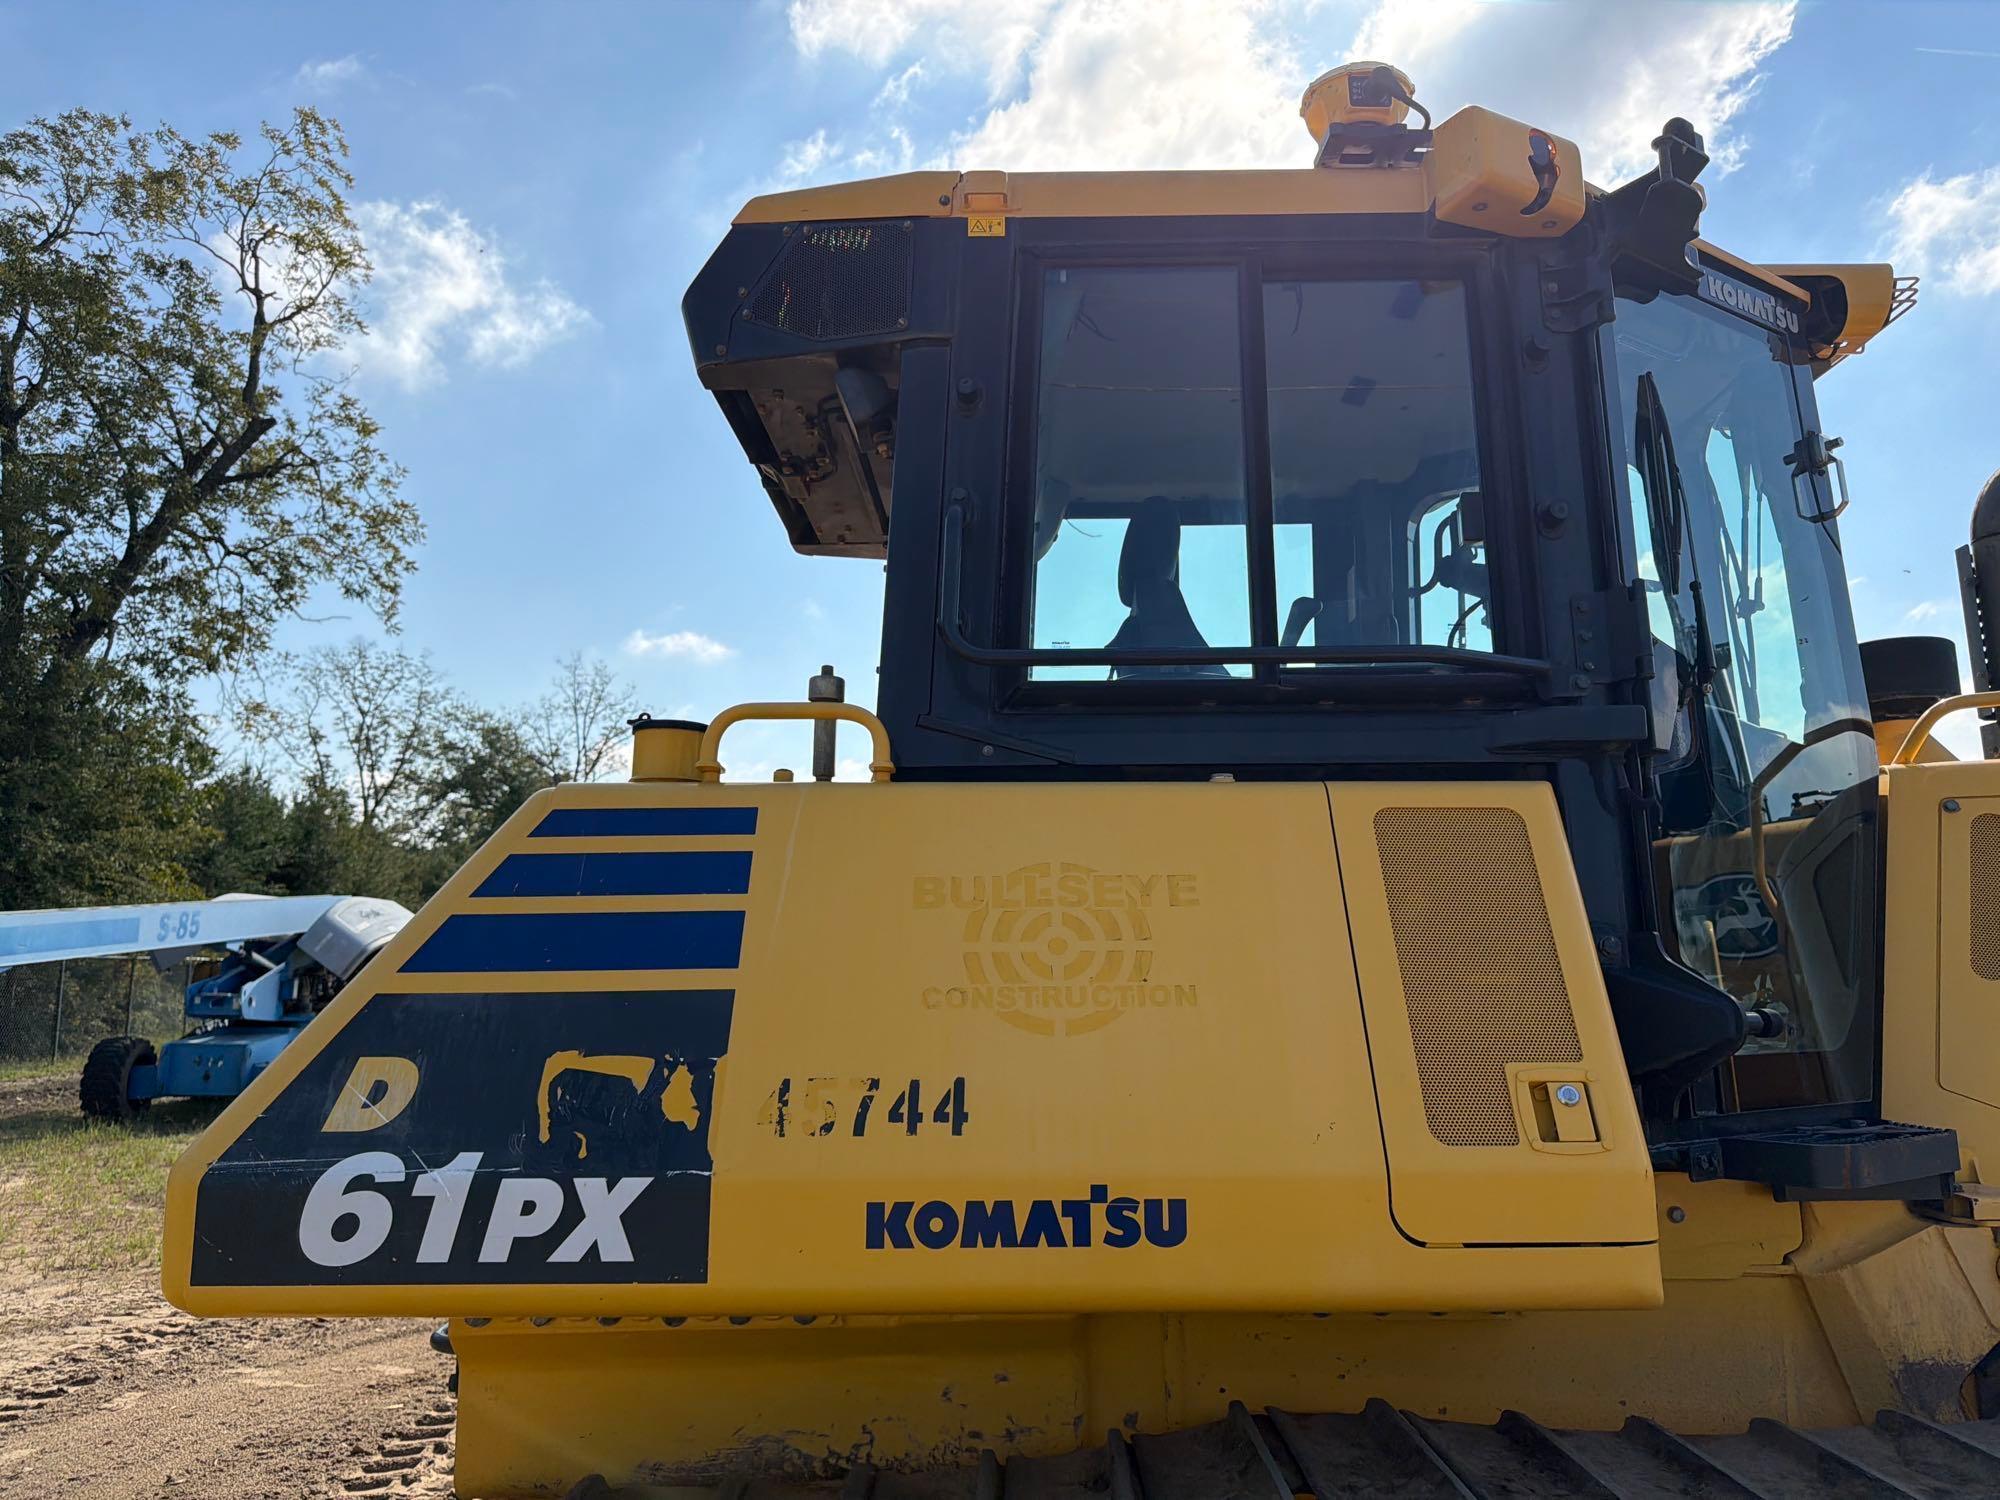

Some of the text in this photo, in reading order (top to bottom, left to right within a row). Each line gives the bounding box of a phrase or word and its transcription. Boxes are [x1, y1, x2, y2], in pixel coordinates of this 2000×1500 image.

[1707, 275, 1799, 334] KOMATSU
[912, 874, 1200, 909] BULLSEYE
[157, 911, 201, 942] S-85
[922, 984, 1199, 1010] CONSTRUCTION
[321, 1056, 420, 1133] D
[299, 1151, 655, 1267] 61PX
[865, 1184, 1188, 1250] KOMATSU
